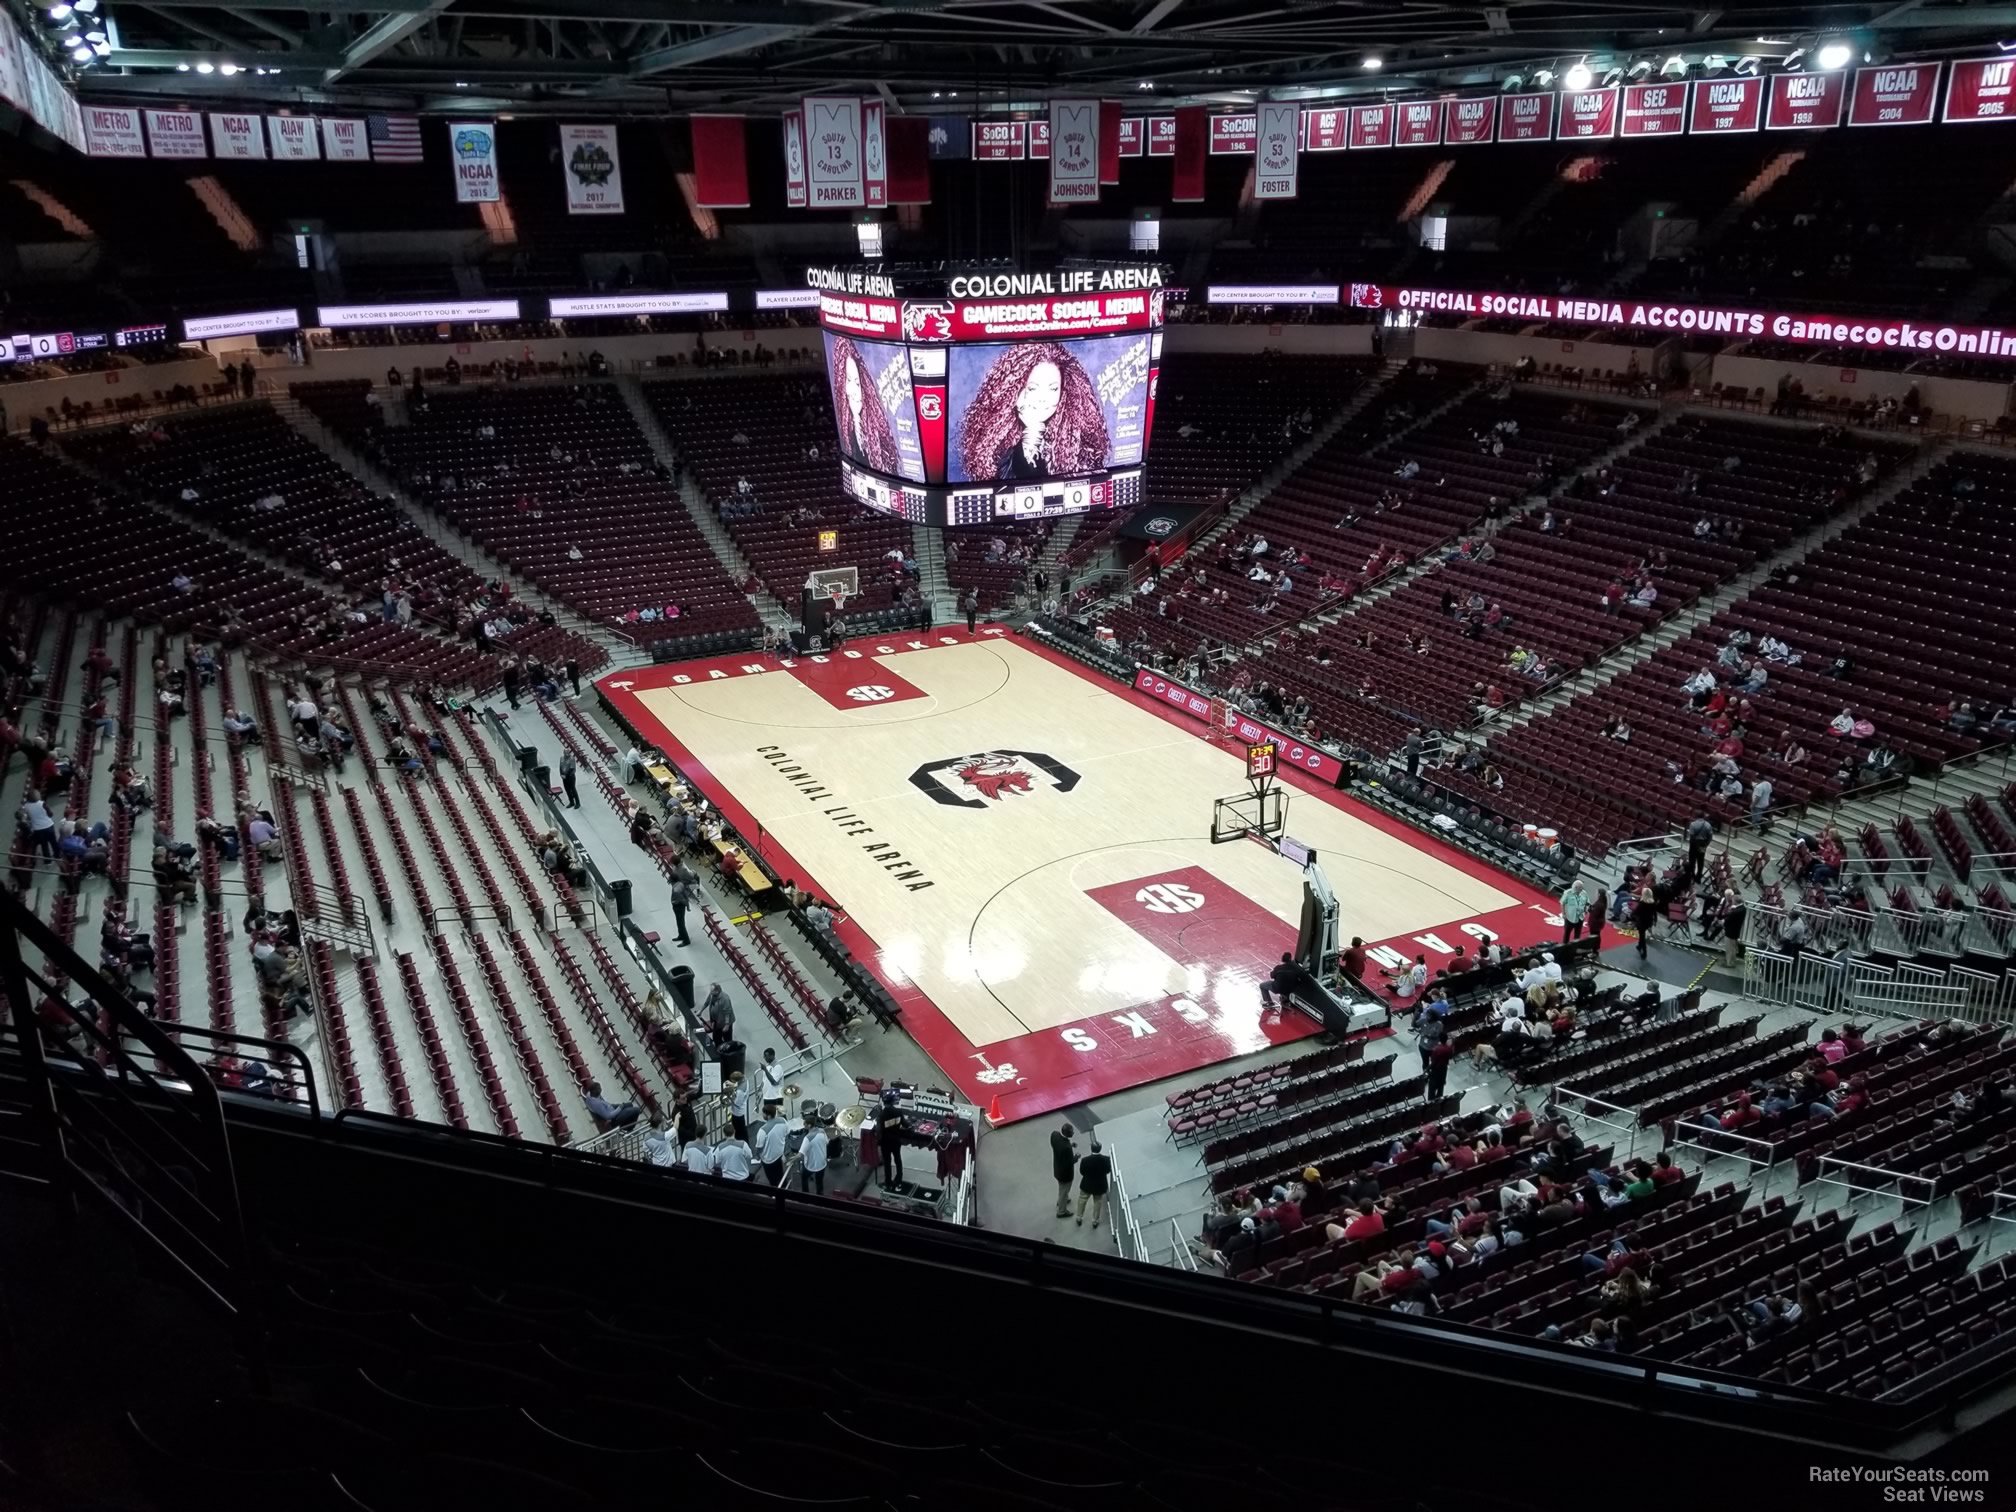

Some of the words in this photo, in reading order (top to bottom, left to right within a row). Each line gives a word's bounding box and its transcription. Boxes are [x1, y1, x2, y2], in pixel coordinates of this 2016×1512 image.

[1873, 69, 1918, 93] NCAA
[1981, 62, 2015, 87] NIT
[1709, 83, 1745, 104] NCAA
[1787, 76, 1826, 98] NCAA
[1573, 94, 1603, 113] NCAA
[1643, 88, 1667, 108] SEC
[1408, 105, 1431, 122] NCAA
[1459, 102, 1484, 120] NCAA
[1513, 98, 1541, 115] NCAA
[1878, 108, 1903, 120] 2004
[1977, 102, 2005, 115] 2005
[92, 111, 132, 130] METRO
[155, 114, 193, 132] METRO
[1222, 118, 1256, 133] SoCON
[1320, 113, 1336, 129] ACC
[1361, 109, 1384, 126] NCAA
[1715, 117, 1734, 128] 1997
[1793, 112, 1813, 124] 1998
[222, 117, 251, 135] NCAA
[281, 120, 304, 136] AIAW
[334, 122, 355, 138] NWIT
[983, 126, 1016, 140] SoCON
[1517, 127, 1532, 137] 1974
[1644, 121, 1661, 131] 1997
[821, 132, 847, 145] SOUTH
[1063, 133, 1086, 144] SOUTH
[1268, 133, 1288, 144] SOUTH
[1412, 132, 1424, 141] 1972
[1461, 131, 1475, 140] 1973
[827, 145, 842, 160] 13
[1068, 144, 1081, 158] 14
[1231, 142, 1246, 151] 1945
[1271, 145, 1283, 156] 53
[816, 159, 853, 175] CAROLINA
[1058, 157, 1090, 172] CAROLINA
[1263, 156, 1291, 170] CAROLINA
[459, 164, 494, 180] NCAA
[469, 188, 488, 198] 2015
[817, 187, 857, 201] PARKER
[1054, 183, 1097, 197] JOHNSON
[1261, 180, 1291, 193] FOSTER
[585, 192, 605, 202] 2017
[807, 267, 847, 292] COLONIAL
[847, 272, 863, 294] LIFE
[864, 274, 896, 299] ARENA
[950, 272, 1056, 298] COLONIAL
[1061, 274, 1094, 295] LIFE
[1099, 267, 1163, 291] ARENA
[963, 303, 1049, 324] GAMECOCK
[1051, 299, 1103, 320] SOCIAL
[1105, 296, 1146, 317] MEDIA
[1398, 290, 1477, 312] OFFICIAL
[1480, 295, 1553, 318] SOCIAL
[1557, 300, 1625, 324] MEDIA
[1630, 306, 1765, 335] ACCOUNTS
[39, 338, 50, 354] 0
[1024, 496, 1034, 510] 0
[1073, 490, 1082, 503] 0
[672, 636, 959, 683] GAMECOCKS
[846, 685, 895, 701] SEC
[1250, 745, 1274, 758] 27:39
[1253, 755, 1272, 773] 30
[756, 745, 833, 801] COLONIAL
[823, 806, 875, 837] LIFE
[862, 843, 935, 892] ARENA
[1135, 883, 1206, 914] SEC
